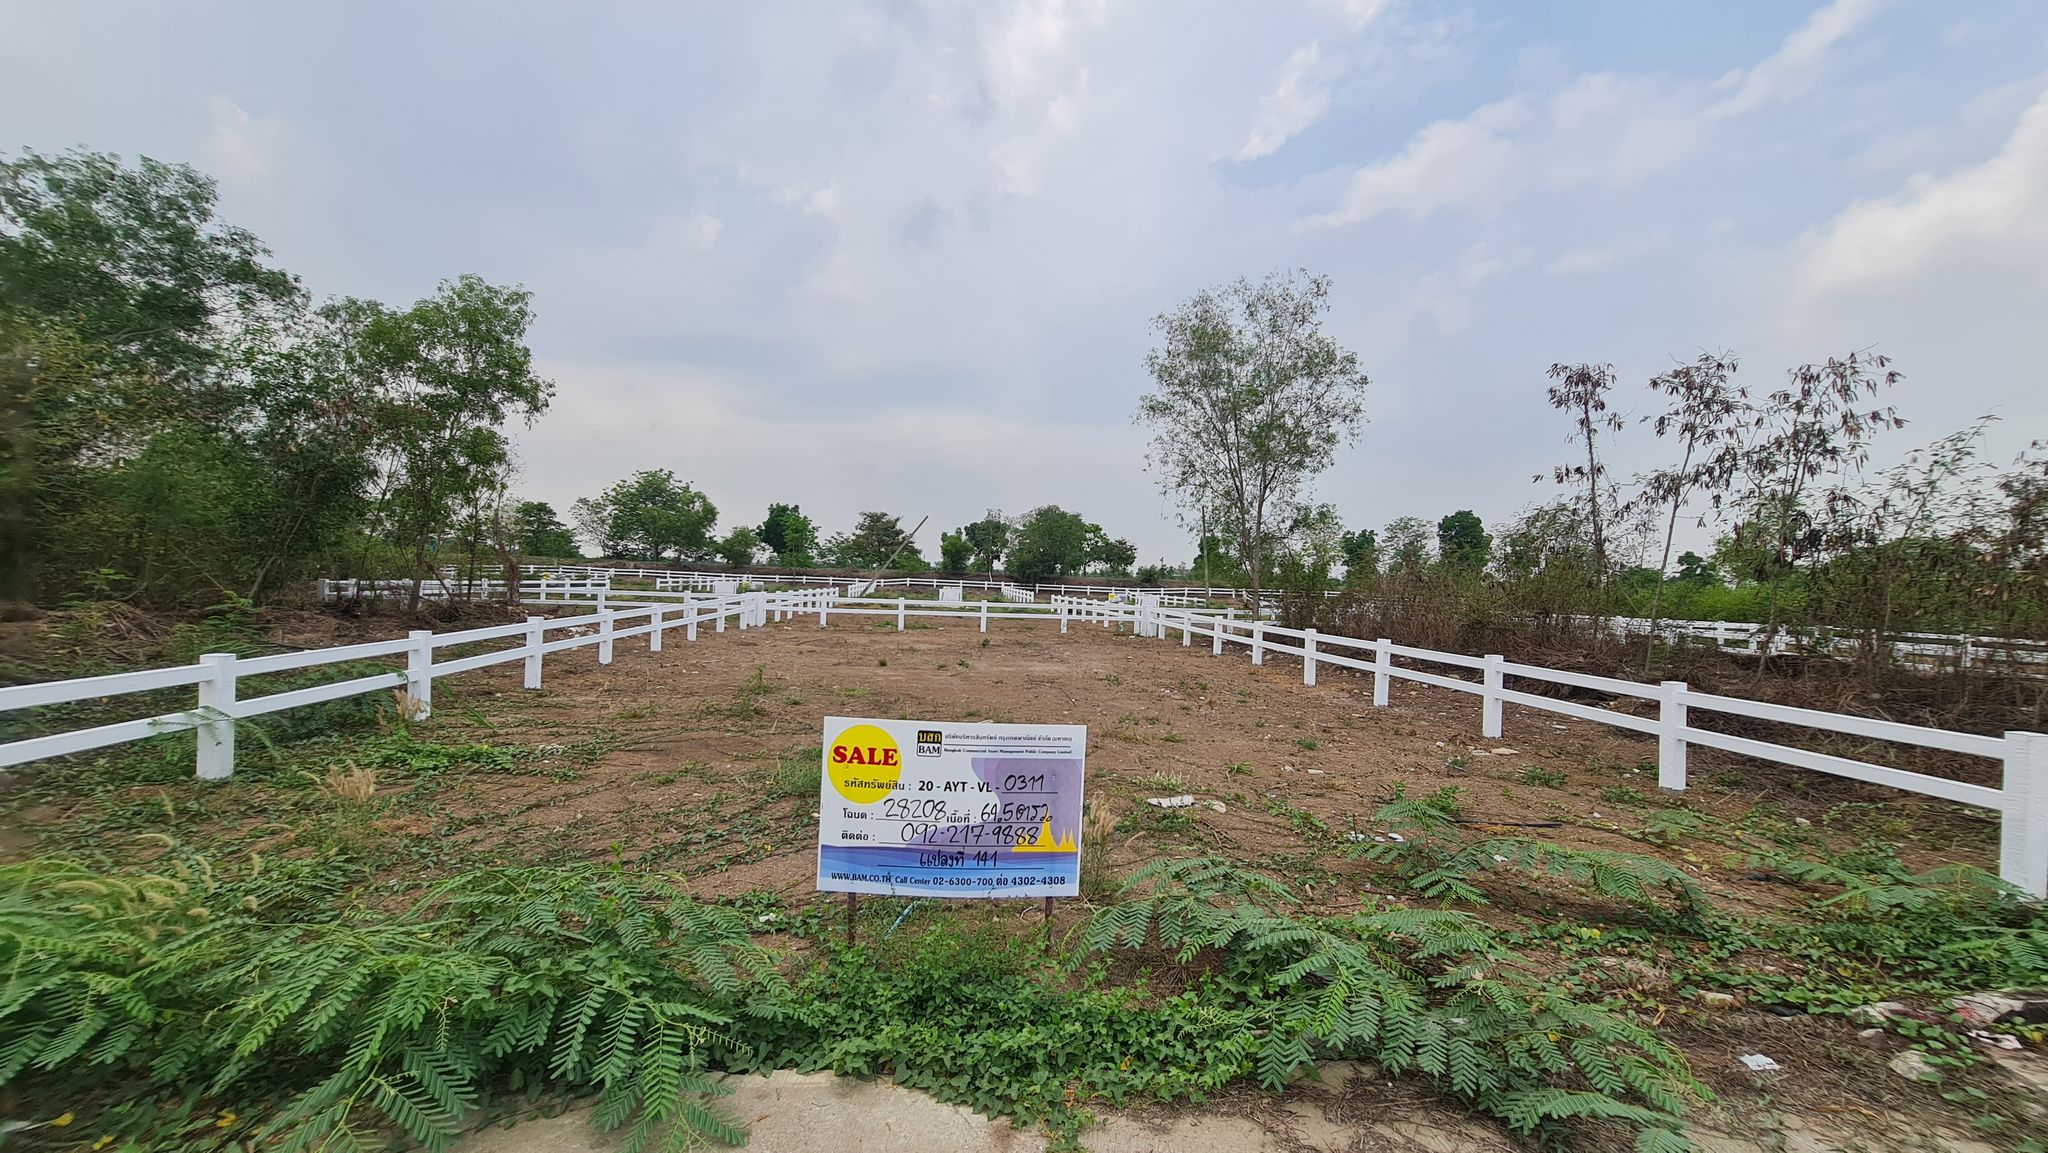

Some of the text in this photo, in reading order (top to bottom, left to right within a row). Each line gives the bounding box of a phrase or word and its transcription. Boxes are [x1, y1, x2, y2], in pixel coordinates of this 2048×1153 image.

[918, 732, 941, 743] บสก
[832, 745, 898, 766] SALE
[918, 745, 941, 754] BAM
[918, 781, 934, 791] 20
[943, 781, 968, 792] AYT
[977, 782, 992, 793] VL
[843, 808, 867, 819] โฉนด
[883, 798, 947, 821] 28208
[901, 823, 1040, 845] 092-217-9888
[973, 850, 998, 867] 141
[895, 876, 908, 884] Call
[909, 876, 931, 885] Center
[932, 876, 993, 886] 02-6300-700
[1011, 876, 1066, 886] 4302-4308
